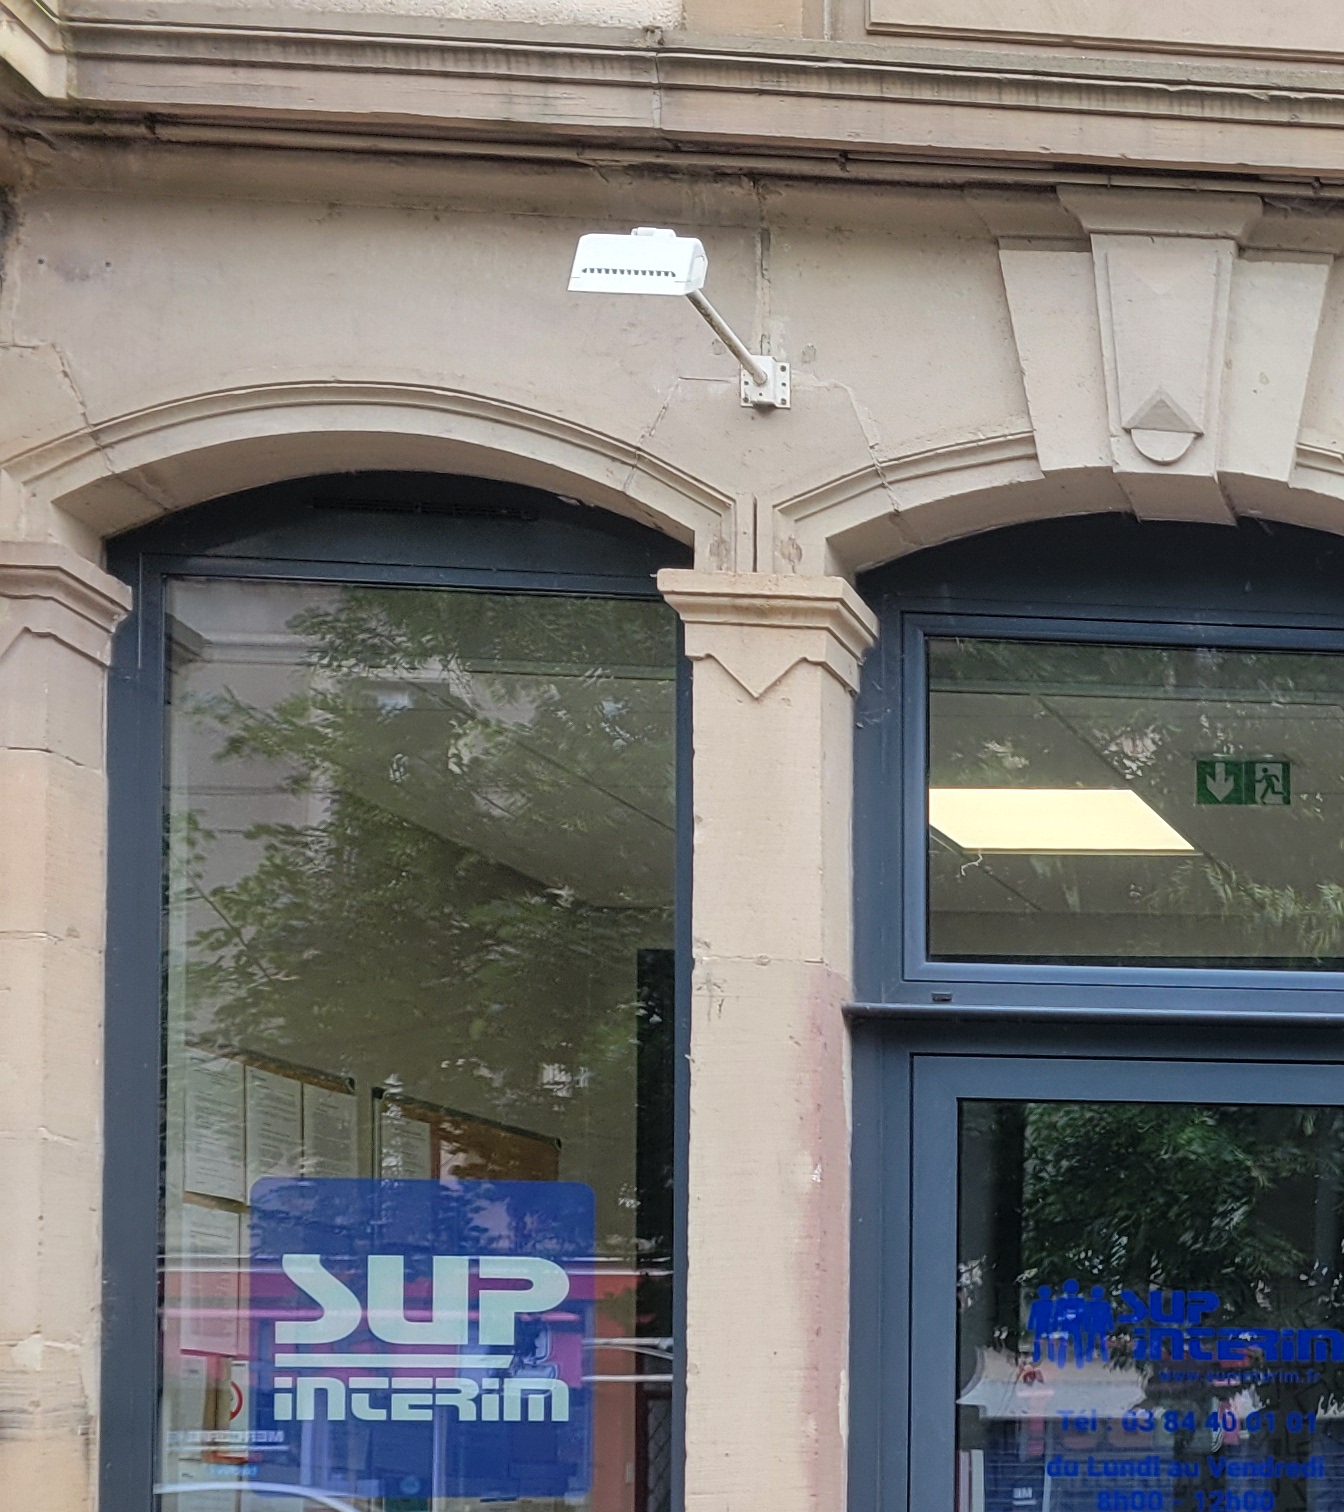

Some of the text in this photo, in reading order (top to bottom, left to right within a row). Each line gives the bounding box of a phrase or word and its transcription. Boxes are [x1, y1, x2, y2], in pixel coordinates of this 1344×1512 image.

[274, 1253, 571, 1346] SUP
[1118, 1290, 1221, 1324] SUP
[1056, 1408, 1098, 1433] Tél
[1121, 1410, 1155, 1433] 03
[1163, 1410, 1197, 1433] 84
[1204, 1410, 1238, 1433] 40
[1245, 1411, 1276, 1433] 01
[1286, 1411, 1318, 1433] 01
[1045, 1454, 1079, 1478] du
[1167, 1461, 1200, 1478] au
[1207, 1456, 1326, 1479] Vendredi
[1096, 1490, 1164, 1512] 8h00
[1192, 1490, 1275, 1512] 12h00
